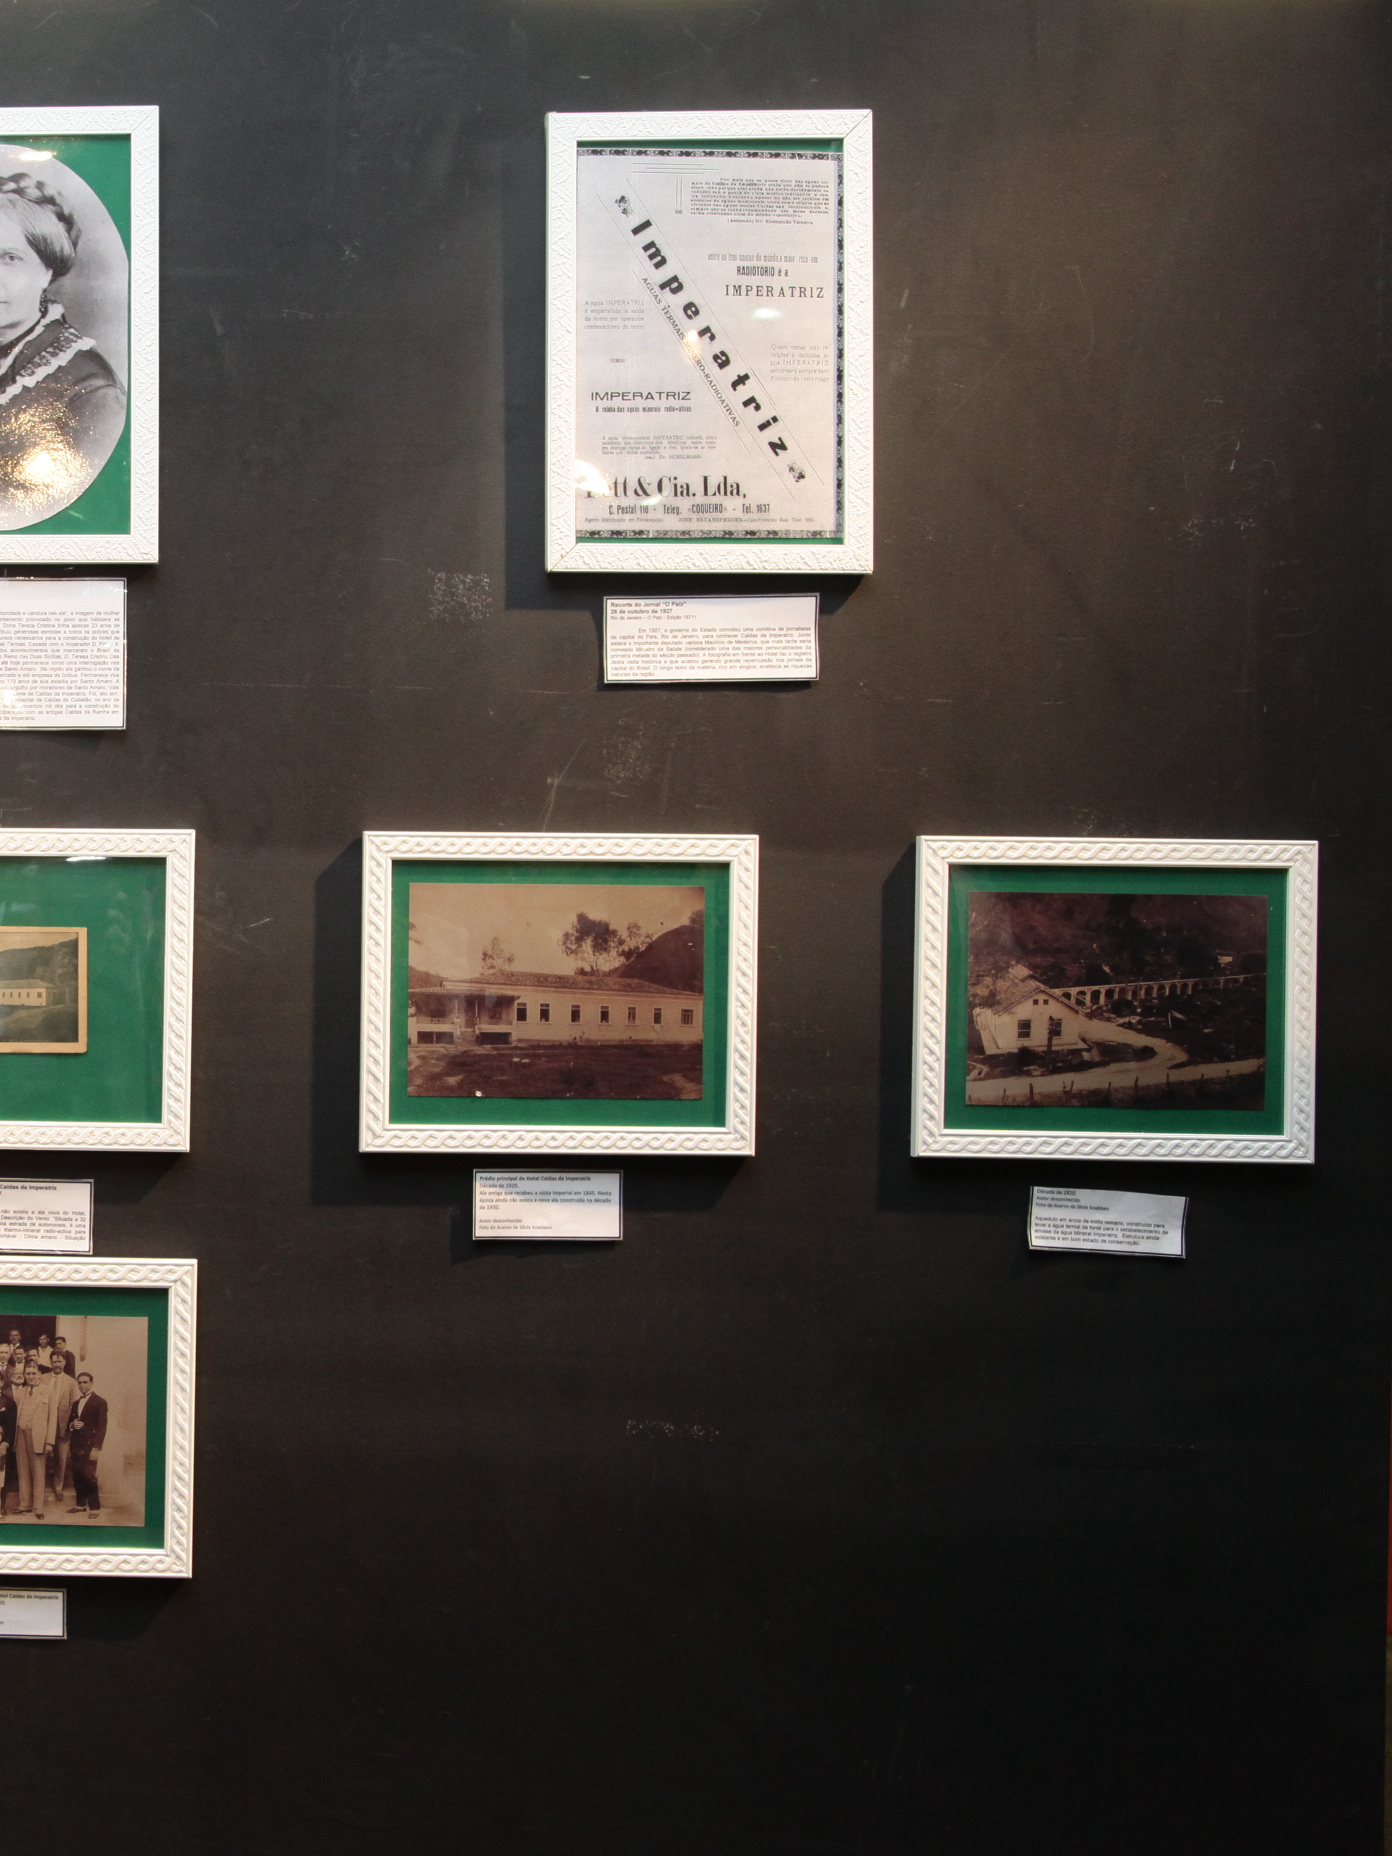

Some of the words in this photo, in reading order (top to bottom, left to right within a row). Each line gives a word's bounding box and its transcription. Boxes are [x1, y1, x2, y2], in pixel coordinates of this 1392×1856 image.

[737, 266, 774, 277] RADIOTORIO
[778, 268, 782, 277] é
[785, 269, 788, 277] a
[725, 285, 824, 298] IMPERATRIZ
[642, 277, 662, 305] AGUAS
[661, 306, 686, 341] TERMAIS
[631, 219, 788, 457] Imperatriz
[591, 391, 691, 401] IMPERATRIZ
[585, 476, 629, 499] tt
[634, 477, 653, 498] &
[657, 475, 696, 498] Cia.
[609, 505, 616, 515] C.
[617, 505, 636, 515] Postal
[640, 505, 649, 514] 118
[663, 504, 681, 515] Teleg.
[742, 504, 753, 514] Tel.
[756, 504, 770, 514] 1637
